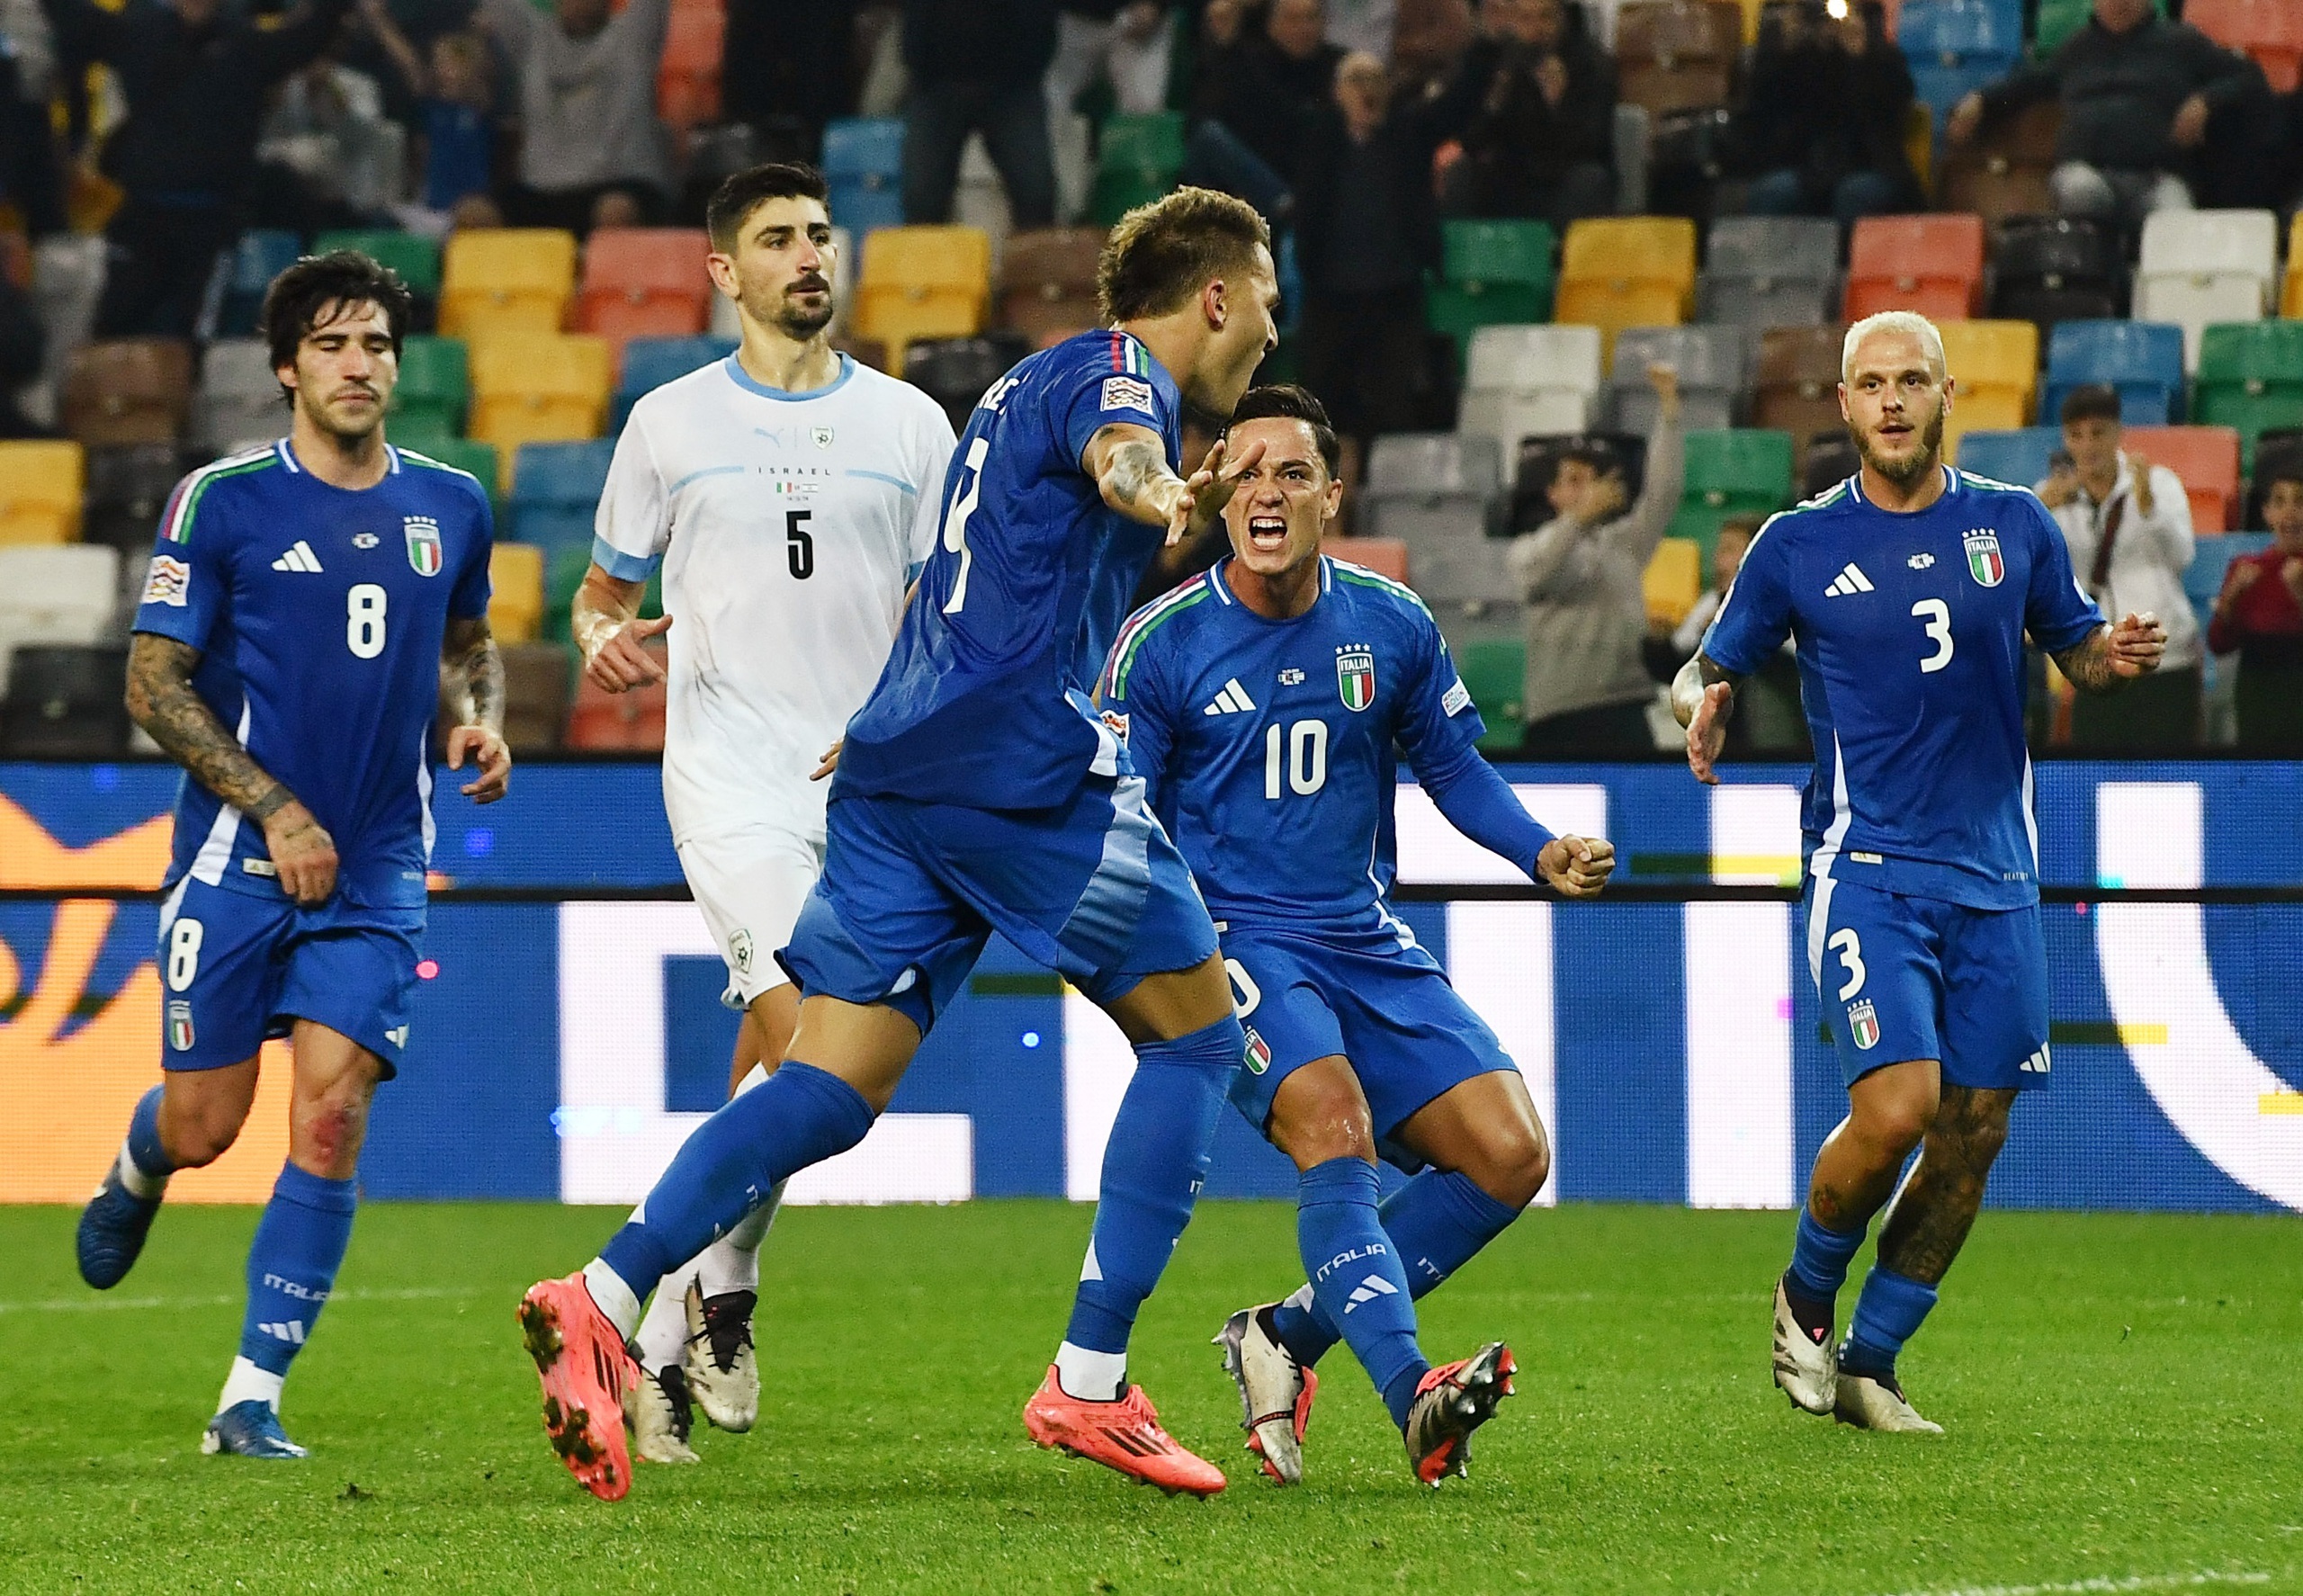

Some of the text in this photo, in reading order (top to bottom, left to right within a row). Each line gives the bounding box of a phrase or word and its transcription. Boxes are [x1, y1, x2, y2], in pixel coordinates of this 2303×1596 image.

[757, 466, 831, 477] ISRAEL
[785, 510, 814, 580] 5
[1967, 540, 1997, 553] ITALIA
[346, 583, 388, 659] 8
[1911, 597, 1955, 674] 3
[1339, 658, 1371, 671] ITALIA
[1265, 719, 1329, 800] 10
[167, 918, 204, 992] 8
[1828, 928, 1867, 1003] 3
[1315, 1242, 1387, 1283] ITALIA
